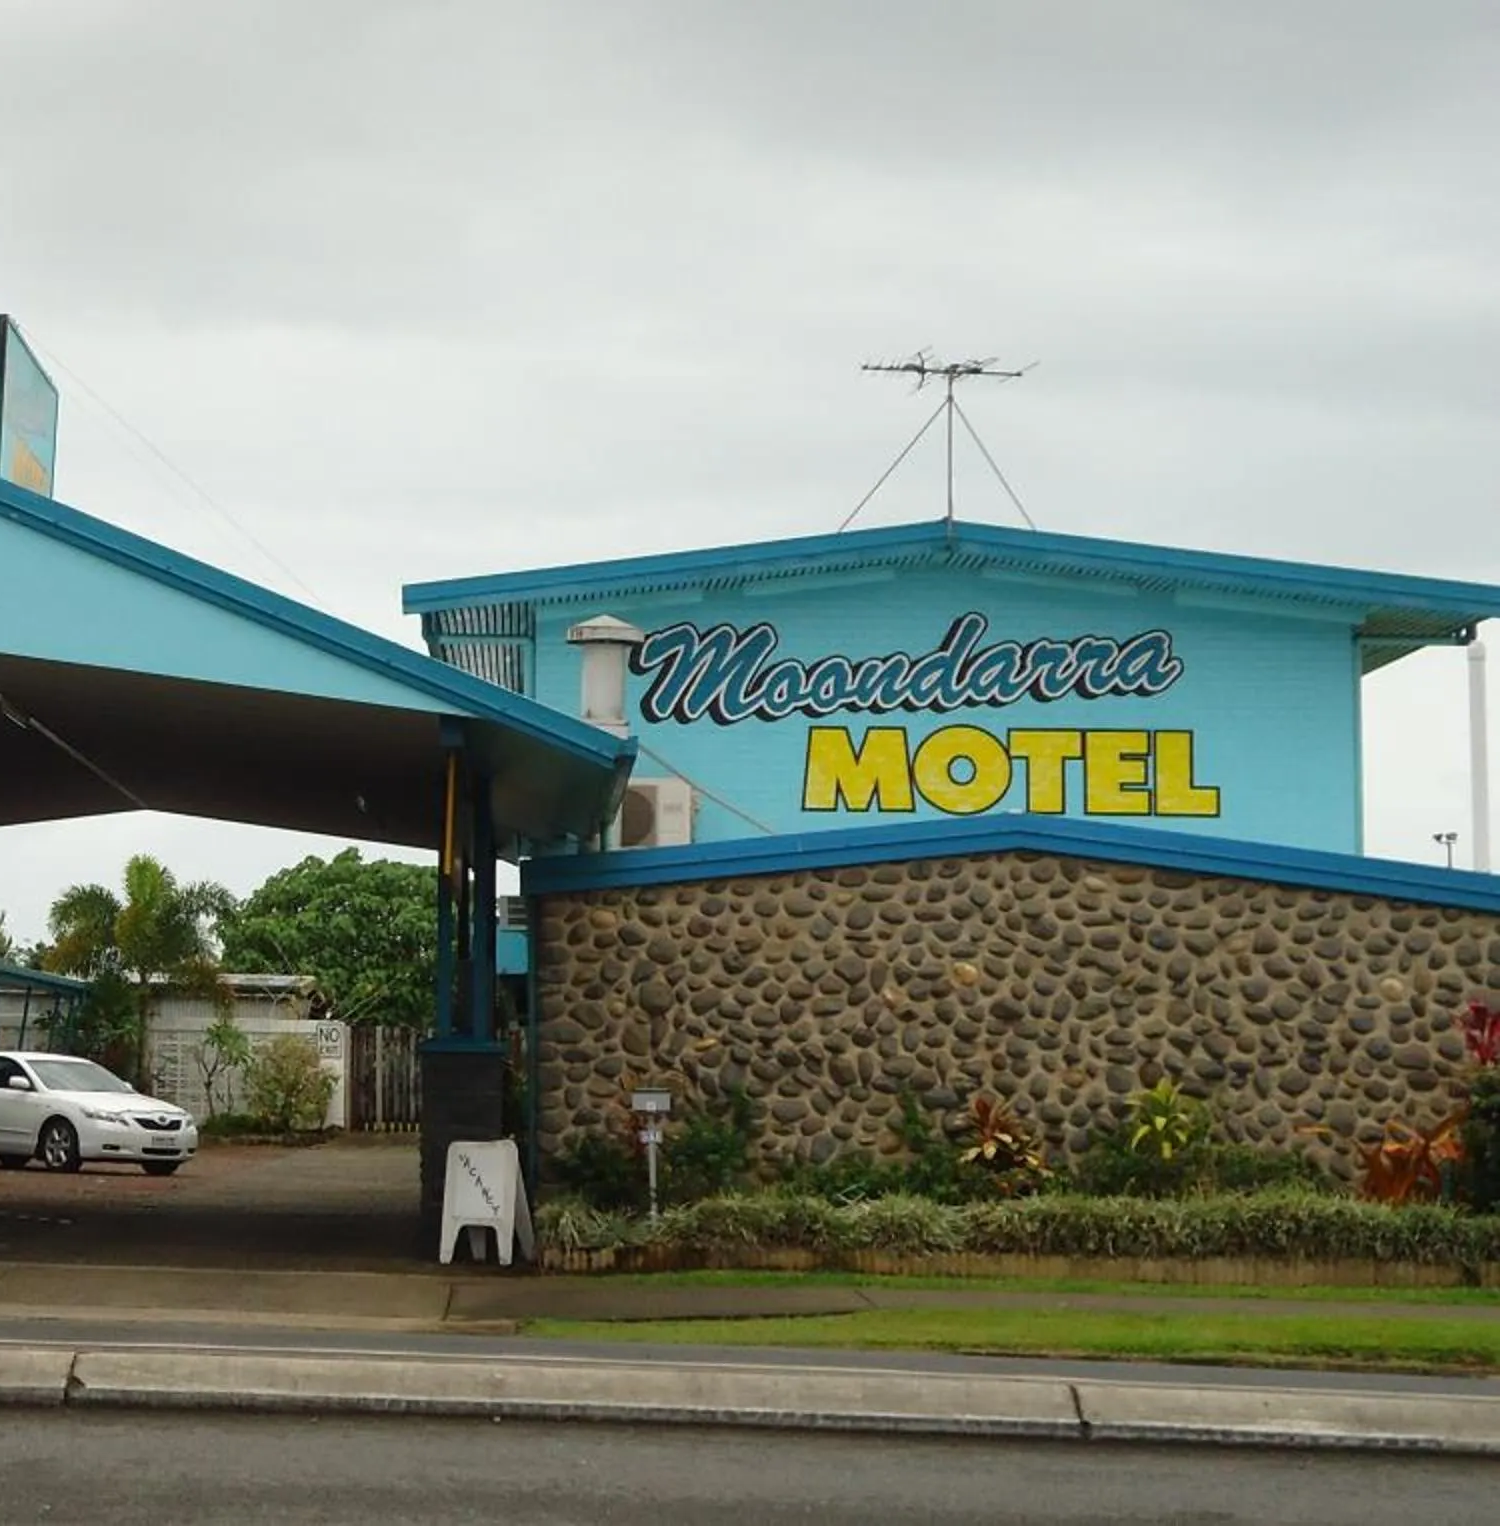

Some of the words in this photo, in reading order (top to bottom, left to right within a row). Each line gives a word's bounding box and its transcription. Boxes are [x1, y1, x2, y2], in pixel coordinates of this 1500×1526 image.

[629, 611, 1183, 725] Moondarra
[801, 724, 1220, 817] MOTEL
[319, 1027, 340, 1042] NO
